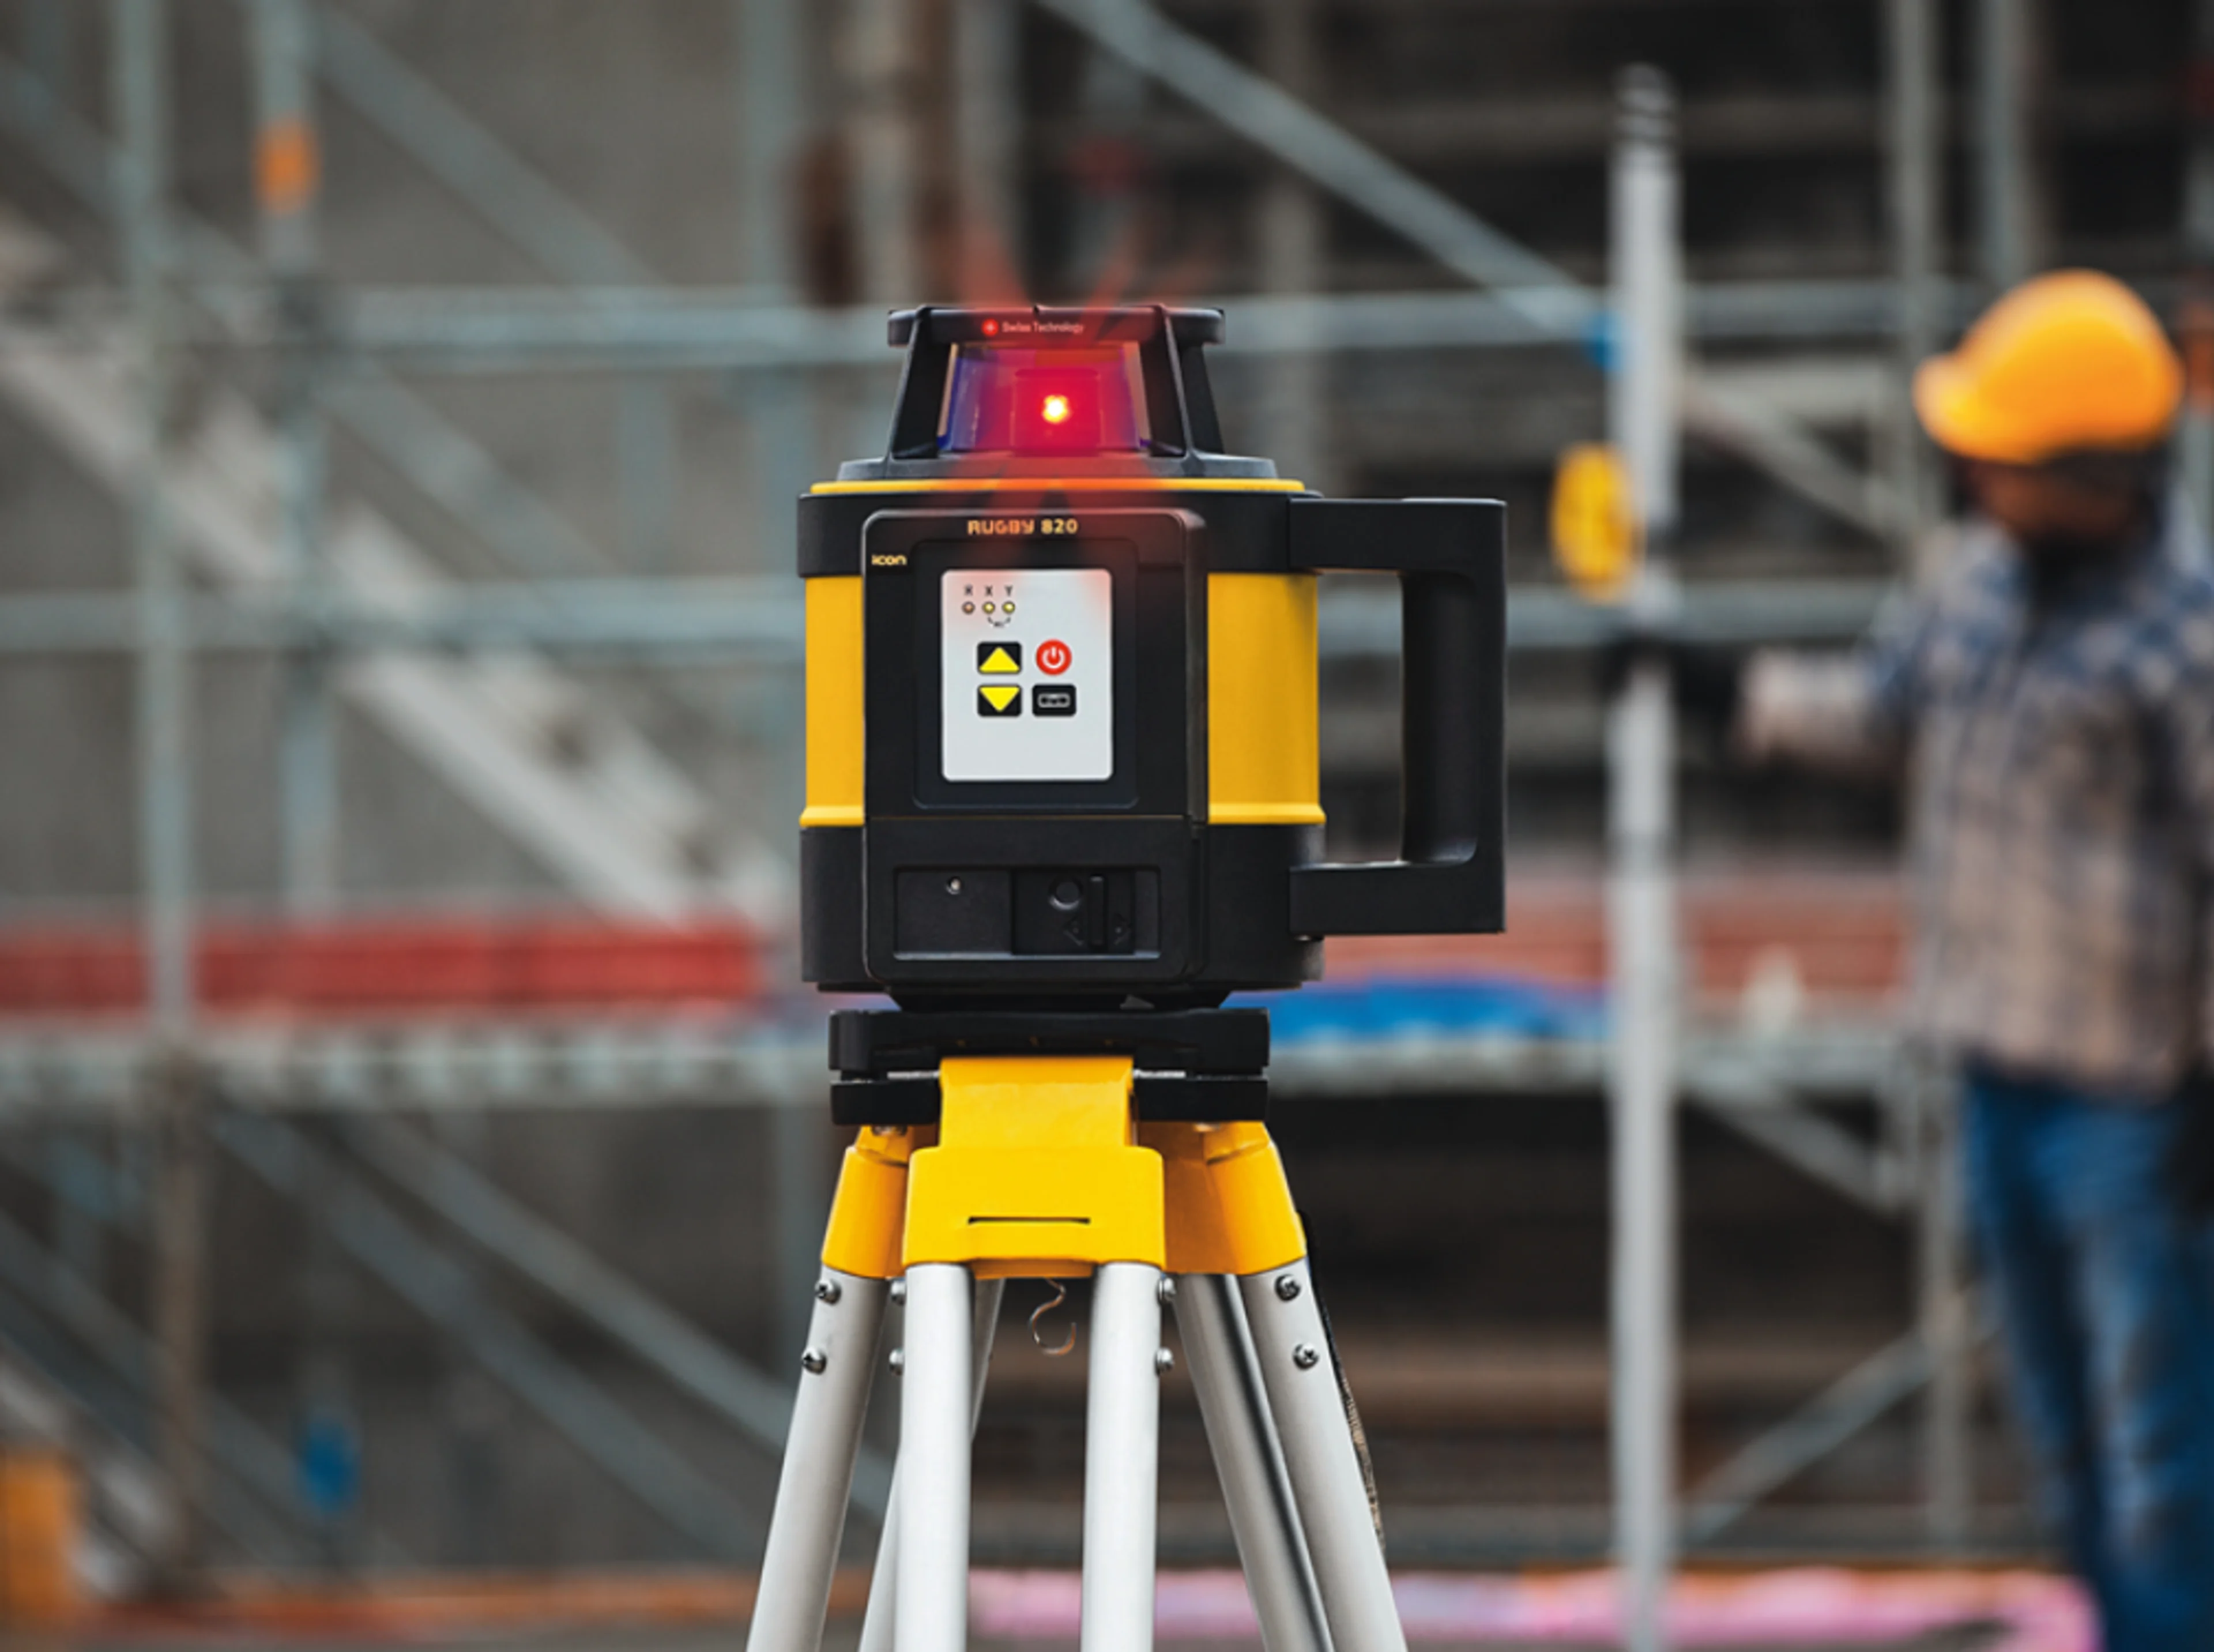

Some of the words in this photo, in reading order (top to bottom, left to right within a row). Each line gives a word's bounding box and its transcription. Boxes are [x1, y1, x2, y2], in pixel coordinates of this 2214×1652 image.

[1002, 322, 1031, 333] Swiss
[1033, 322, 1085, 334] Technology
[967, 520, 1034, 536] RUGBY
[1041, 518, 1079, 535] 820
[871, 554, 908, 566] icon
[984, 585, 993, 596] X
[1004, 585, 1014, 596] Y
